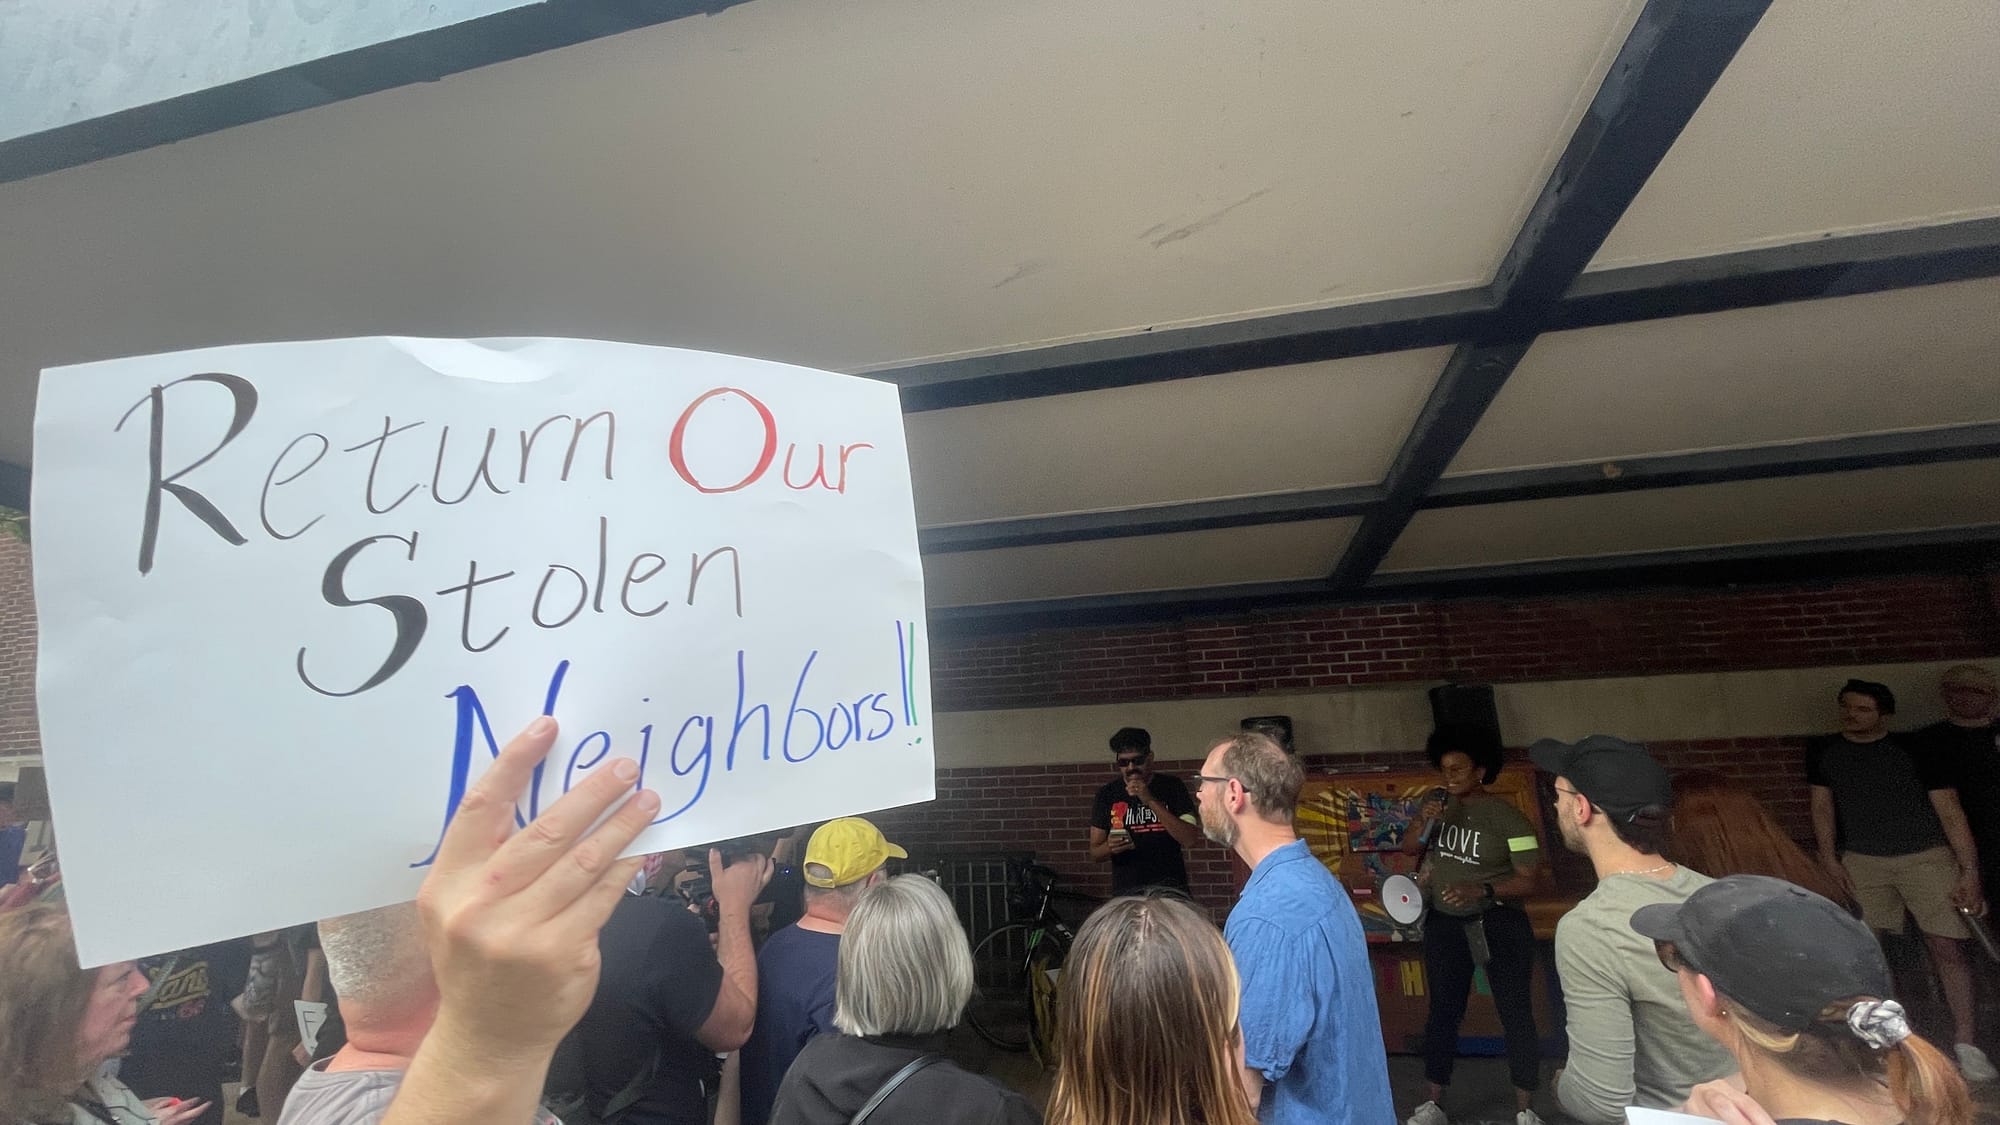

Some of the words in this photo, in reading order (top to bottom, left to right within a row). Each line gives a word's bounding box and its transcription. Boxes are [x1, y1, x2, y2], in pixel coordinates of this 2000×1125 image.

[115, 371, 616, 577] Return
[668, 387, 876, 494] Our
[297, 516, 744, 697] Stolen
[1438, 821, 1481, 858] LOVE
